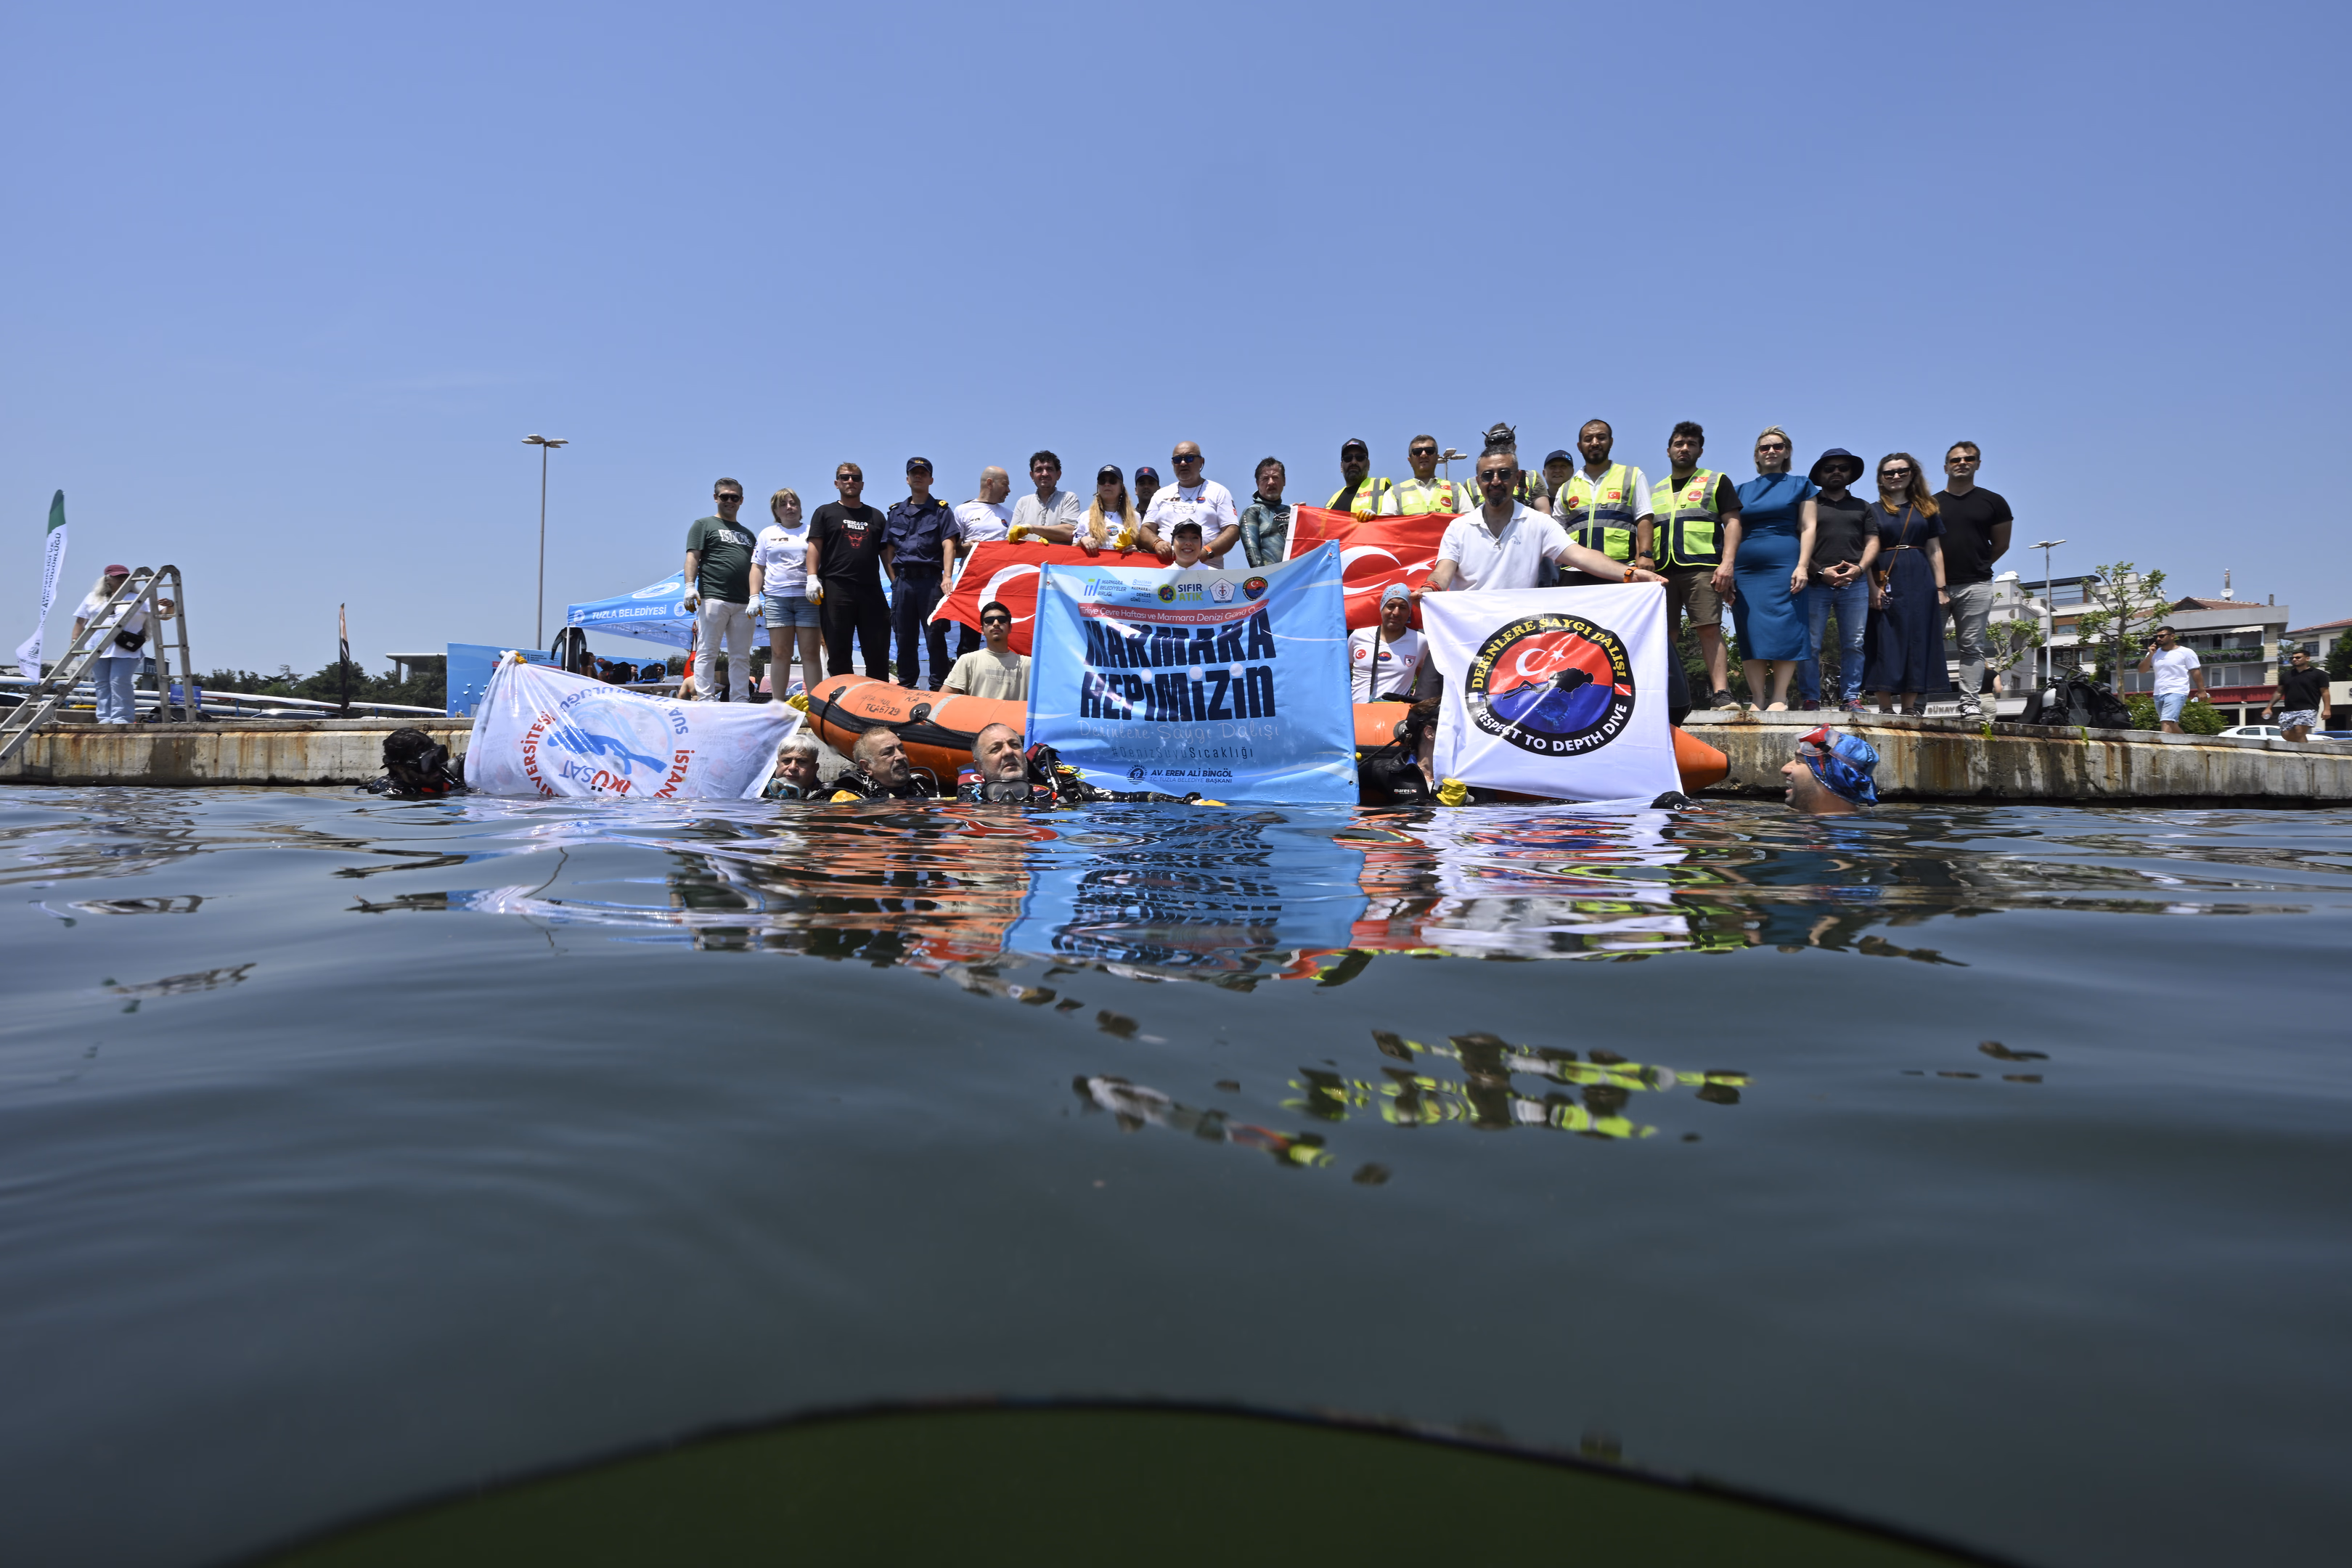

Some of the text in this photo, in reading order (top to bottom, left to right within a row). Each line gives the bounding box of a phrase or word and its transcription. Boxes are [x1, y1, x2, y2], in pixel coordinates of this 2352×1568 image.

[1177, 584, 1202, 592] SIFIR
[1179, 592, 1203, 601] ATIK
[592, 605, 666, 620] TUZLA BELEDİYESİ
[1079, 607, 1098, 616] Türkiye
[1157, 613, 1195, 621] Marmara
[1225, 609, 1247, 619] Günü
[1084, 608, 1276, 668] MARMARA
[1538, 618, 1593, 636] SAYGI
[1590, 632, 1627, 677] DALIŞI
[1927, 706, 1960, 714] GÜNAY
[1077, 720, 1278, 744] Derinlere Saygı Dalışı
[1476, 703, 1628, 752] RESPECT TO DEPTH DIVE
[1111, 746, 1254, 759] #DenizSuyuSıcaklığı
[1187, 767, 1201, 777] ALİ
[1202, 767, 1233, 777] BİNGÖL
